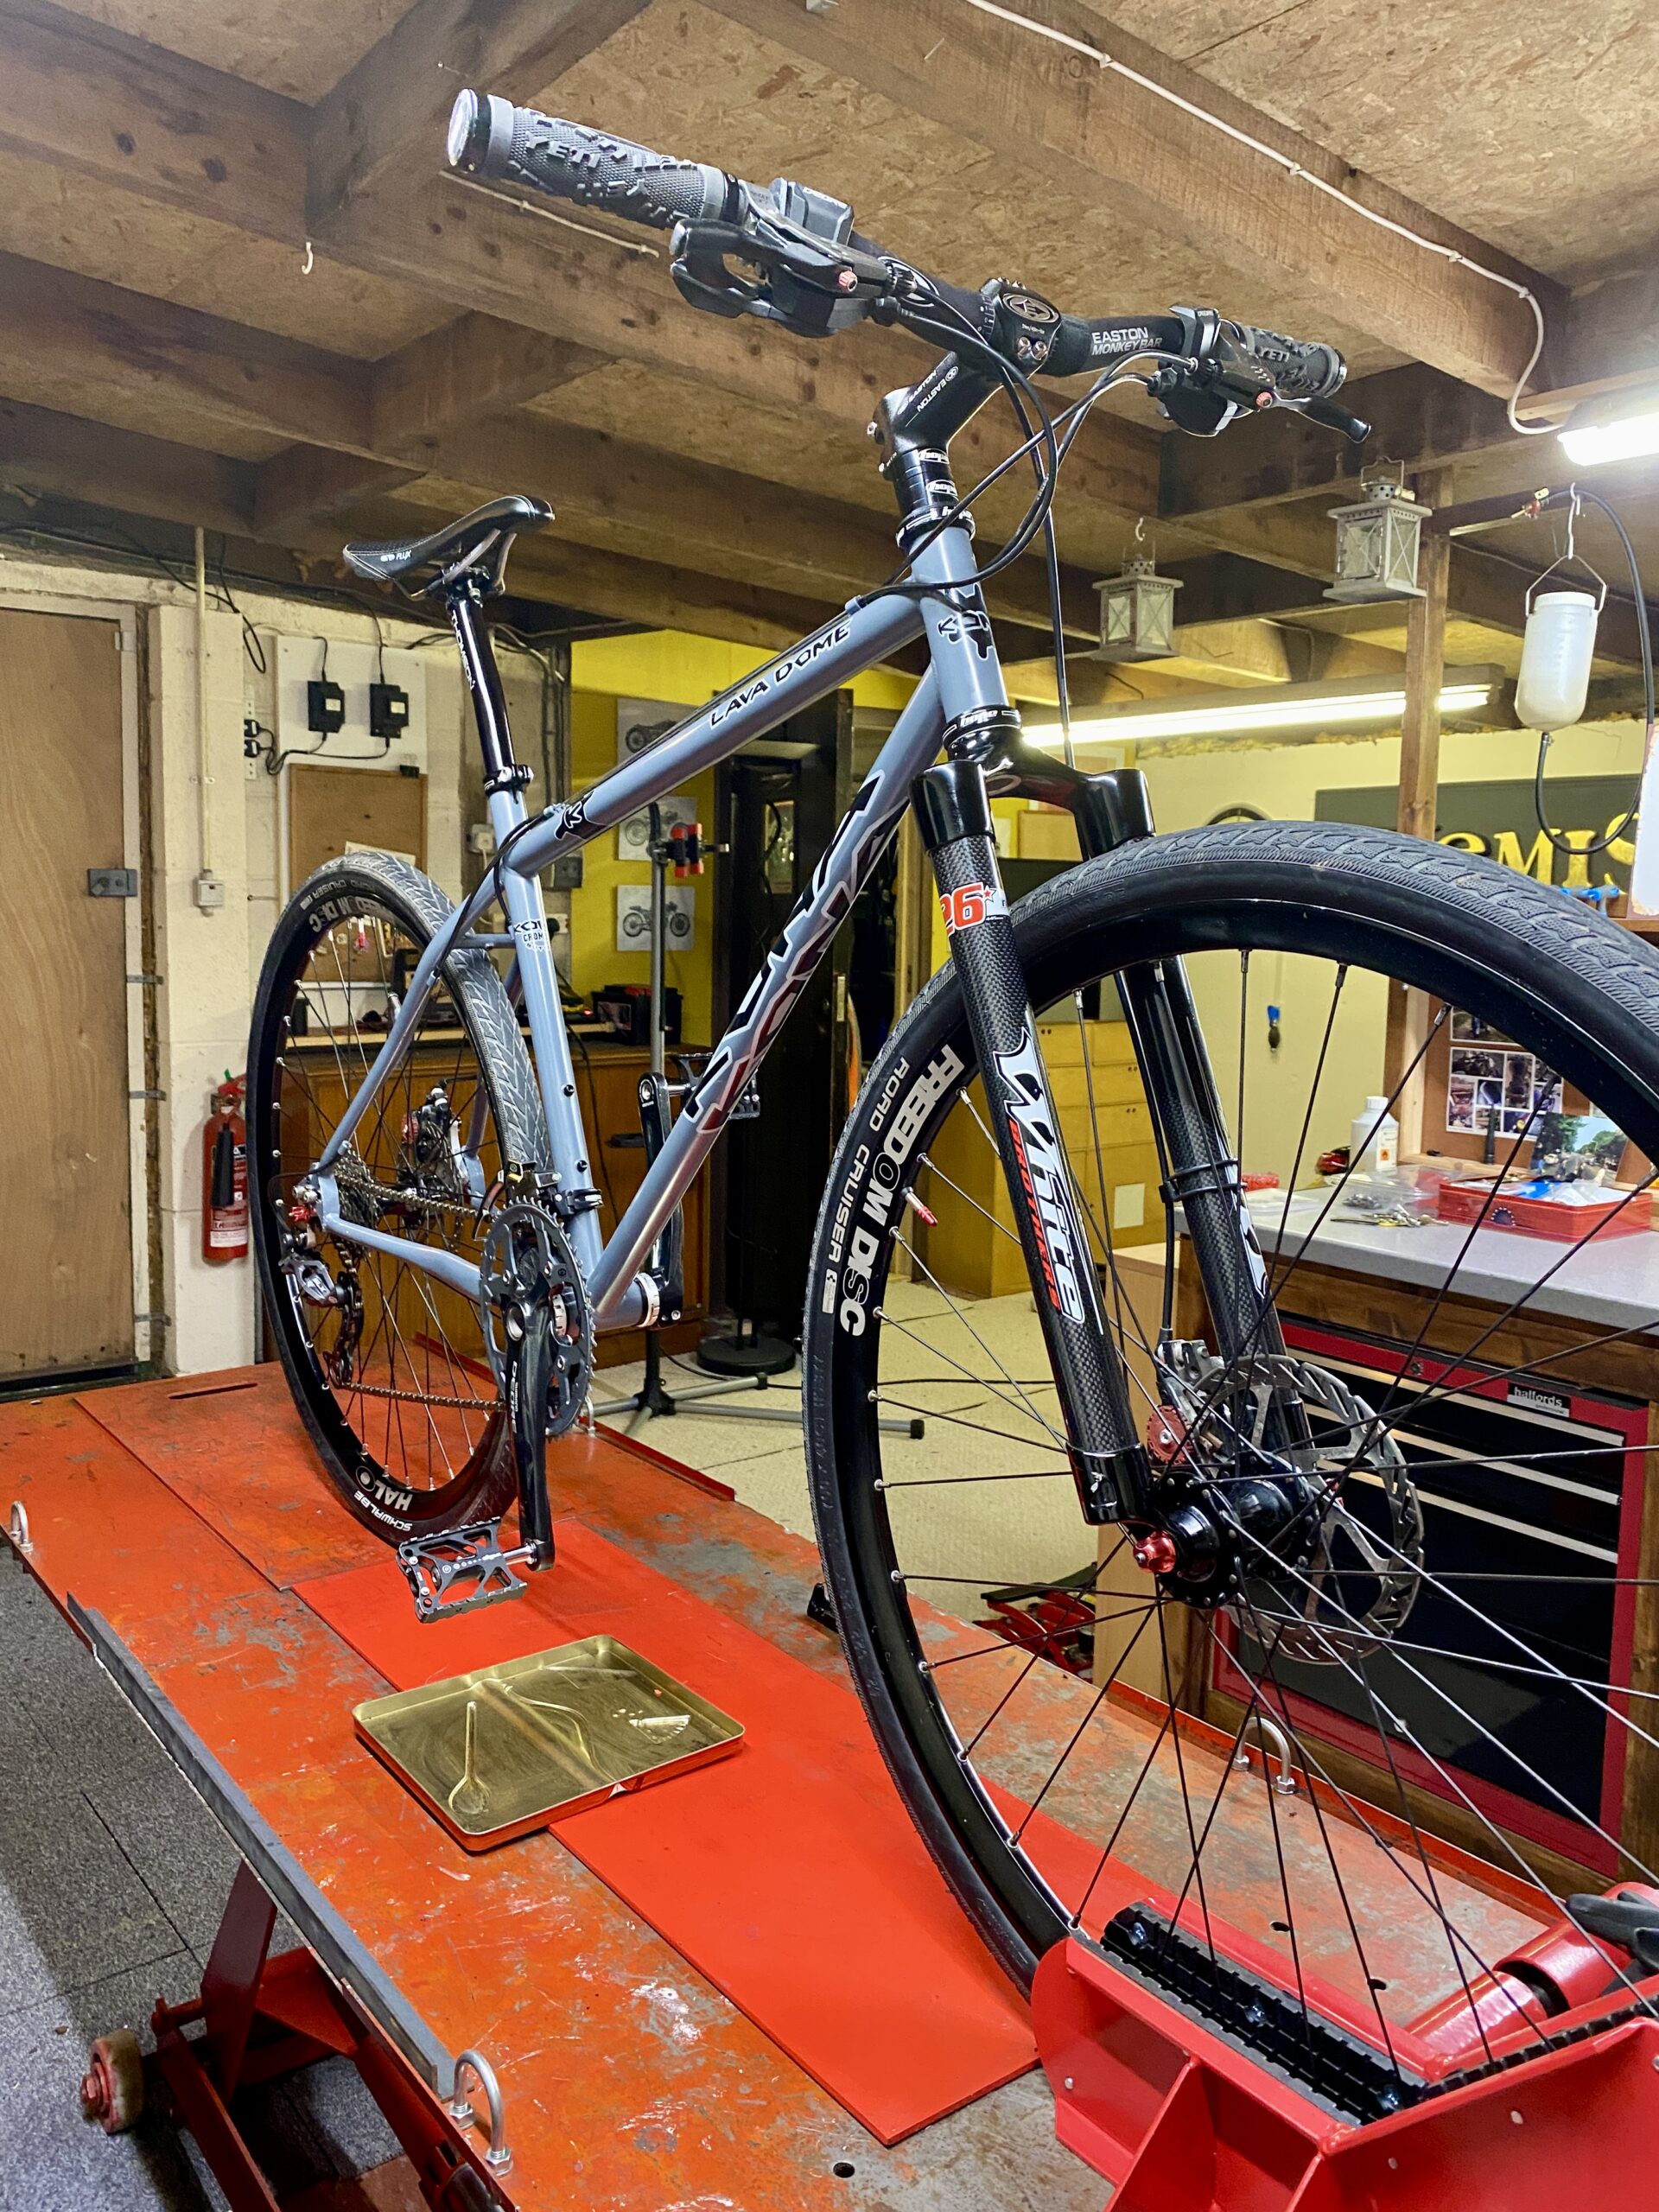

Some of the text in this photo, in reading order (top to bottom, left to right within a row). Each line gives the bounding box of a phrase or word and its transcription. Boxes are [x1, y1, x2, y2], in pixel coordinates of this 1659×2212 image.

[525, 130, 601, 170] YETI
[1092, 327, 1150, 345] EASTON
[1259, 346, 1290, 362] YETI
[916, 378, 948, 413] EASTON
[396, 550, 413, 562] FLUX
[710, 620, 853, 728] LAVA DOME
[869, 1056, 911, 1133] ROAD
[839, 1043, 965, 1338] FREEDOM DISC
[994, 1025, 1085, 1324] White
[827, 1142, 871, 1264] CRUISER
[1007, 1117, 1062, 1302] BROTHERS
[1513, 1385, 1563, 1408] halfords
[353, 1490, 414, 1532] SCHWALBE
